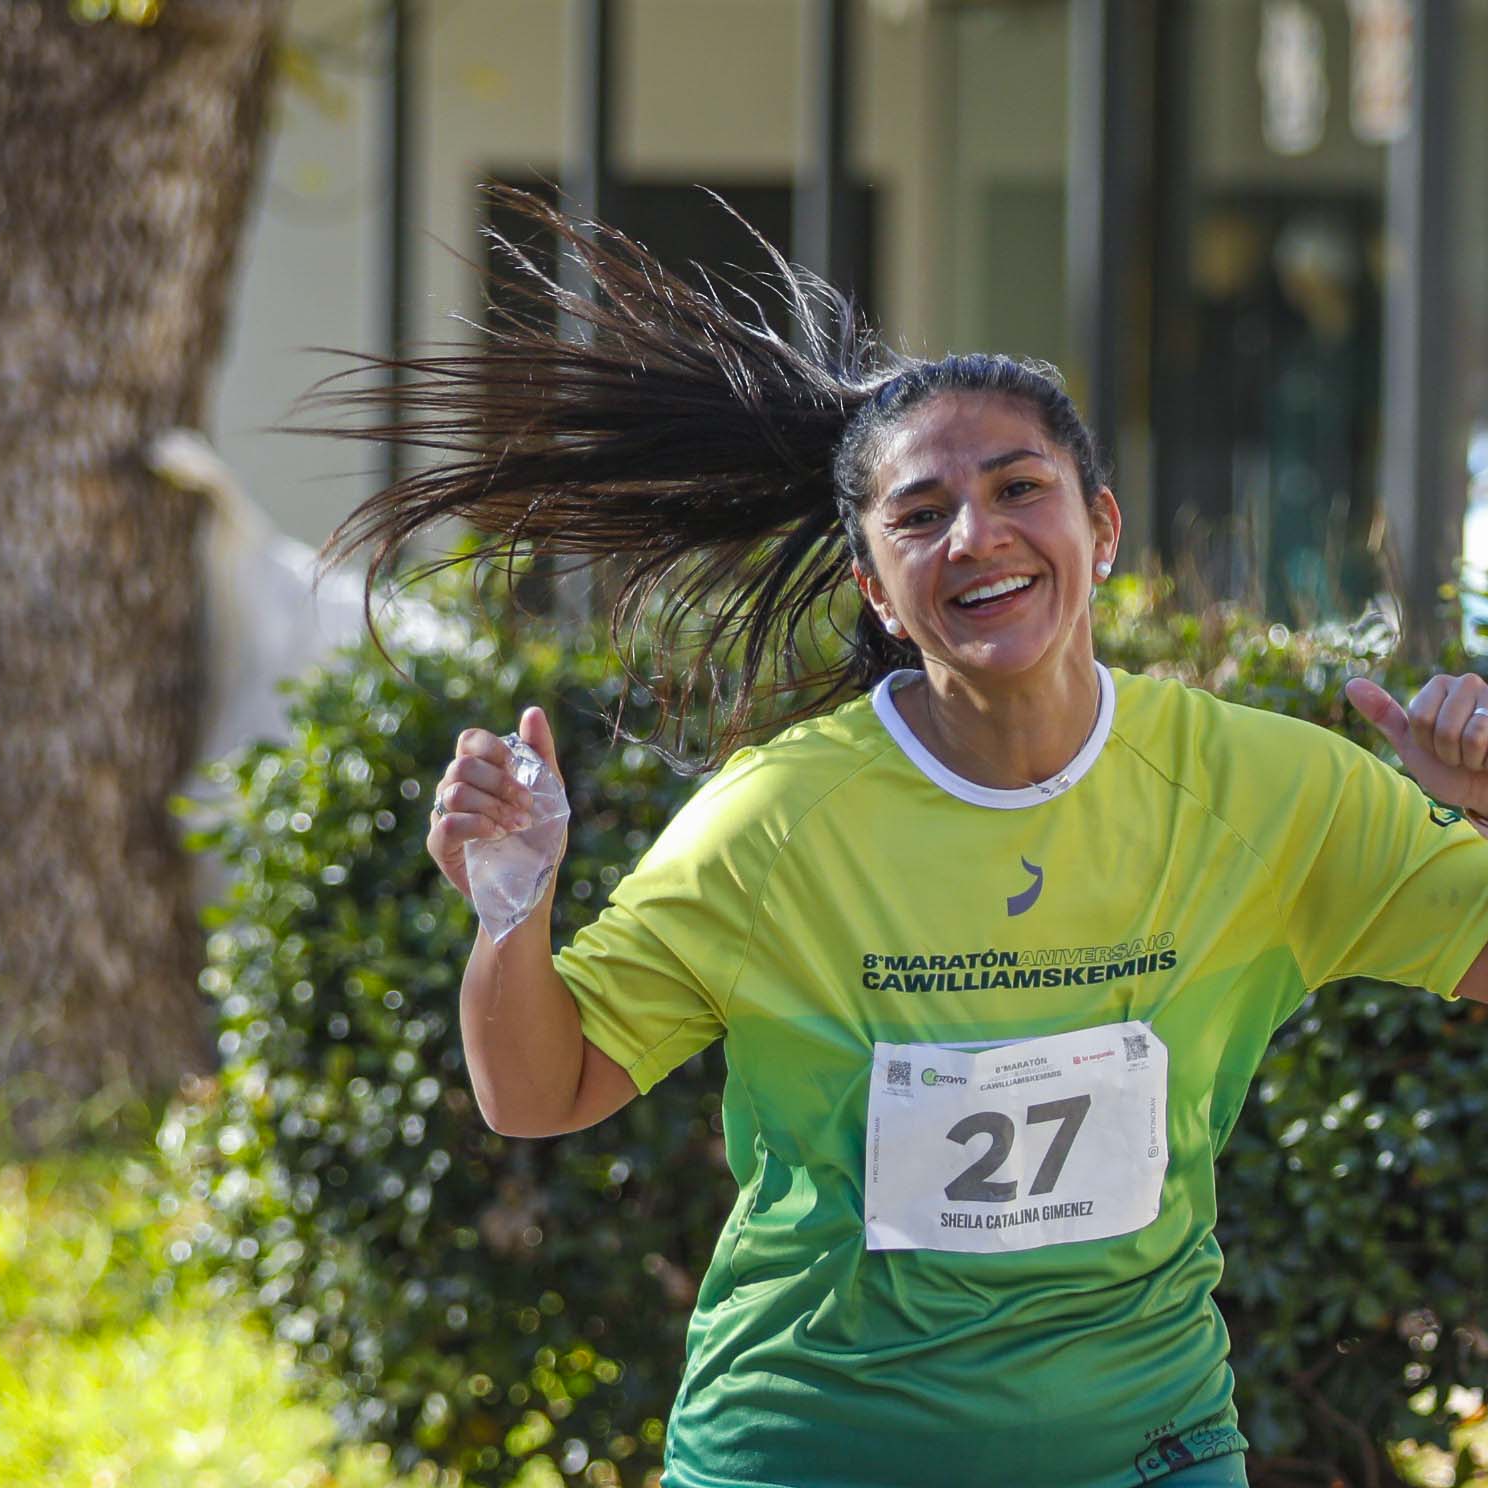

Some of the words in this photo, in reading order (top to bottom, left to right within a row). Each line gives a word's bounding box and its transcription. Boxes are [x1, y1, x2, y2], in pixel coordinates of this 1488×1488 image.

[944, 1094, 1092, 1202] 27
[941, 1212, 982, 1229] SHEILA
[986, 1208, 1040, 1229] CATALINA
[1042, 1201, 1094, 1220] GIMENEZ
